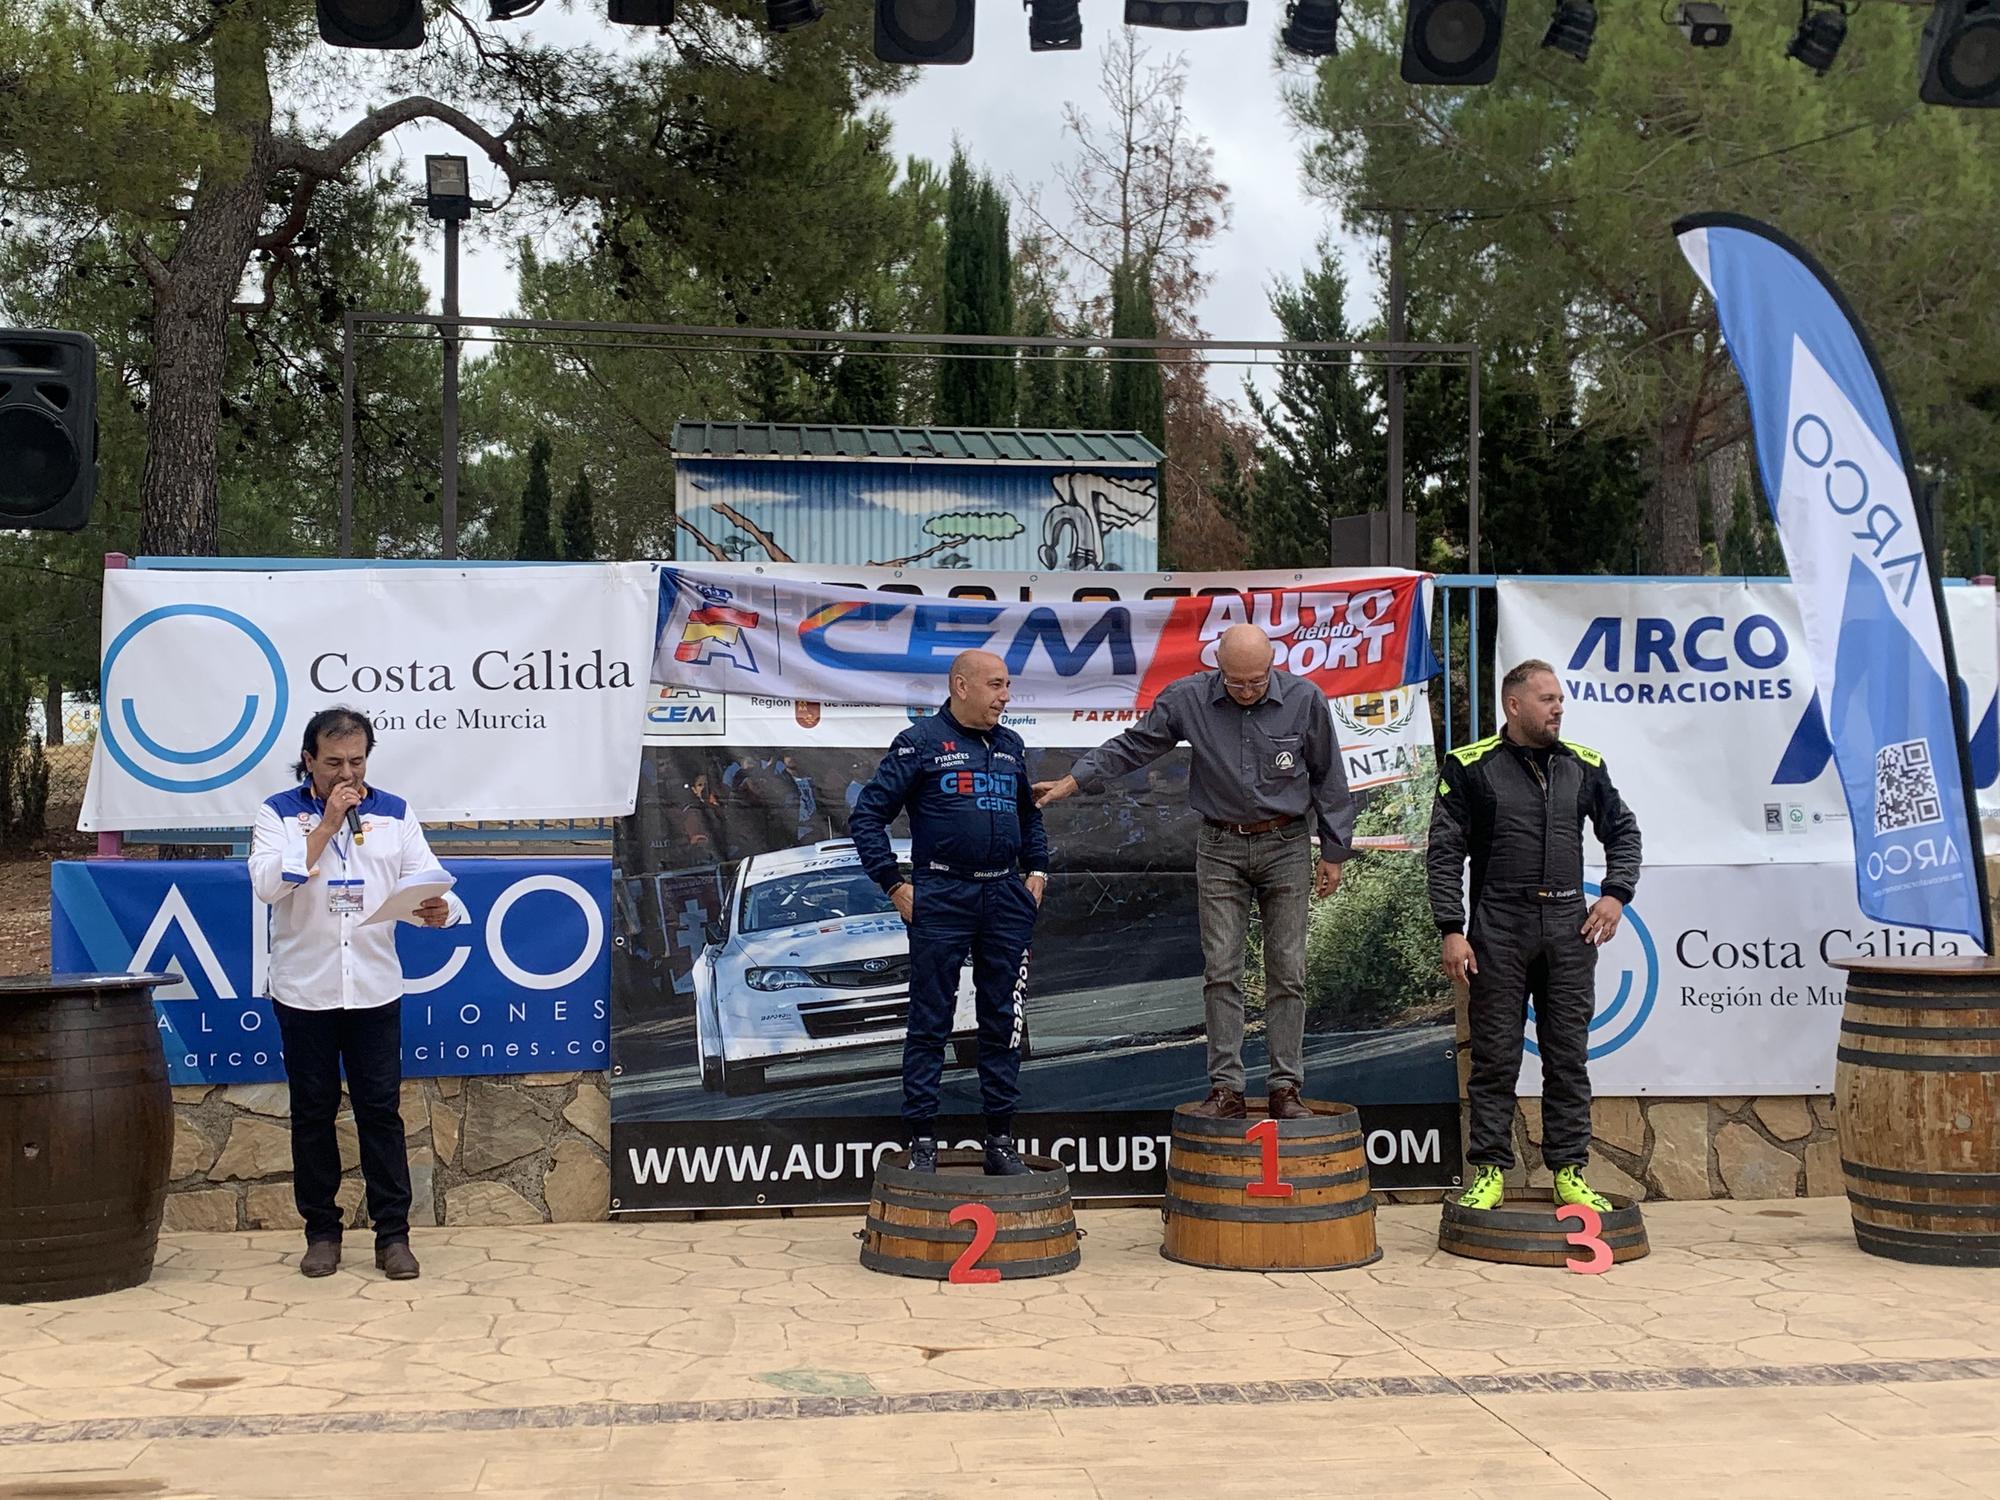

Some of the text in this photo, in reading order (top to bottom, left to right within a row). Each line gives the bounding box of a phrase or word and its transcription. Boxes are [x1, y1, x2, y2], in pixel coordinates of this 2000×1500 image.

[1198, 588, 1395, 641] AUTO
[1293, 622, 1356, 641] hebdo
[798, 601, 1137, 677] CEM
[1200, 622, 1395, 676] ORT
[1567, 613, 1790, 673] ARCO
[309, 649, 636, 694] Costa Cálida
[1565, 678, 1793, 704] VALORACIONES
[415, 709, 447, 730] de
[456, 708, 548, 730] Murcia
[647, 705, 716, 723] CEM
[1001, 714, 1037, 727] Deportes
[1348, 745, 1410, 779] NTA
[1676, 928, 1805, 969] Costa
[1680, 985, 1762, 1013] Región
[1770, 985, 1798, 1006] de
[1245, 1119, 1294, 1197] 1
[947, 1202, 1001, 1285] 2
[1555, 1203, 1615, 1275] 3
